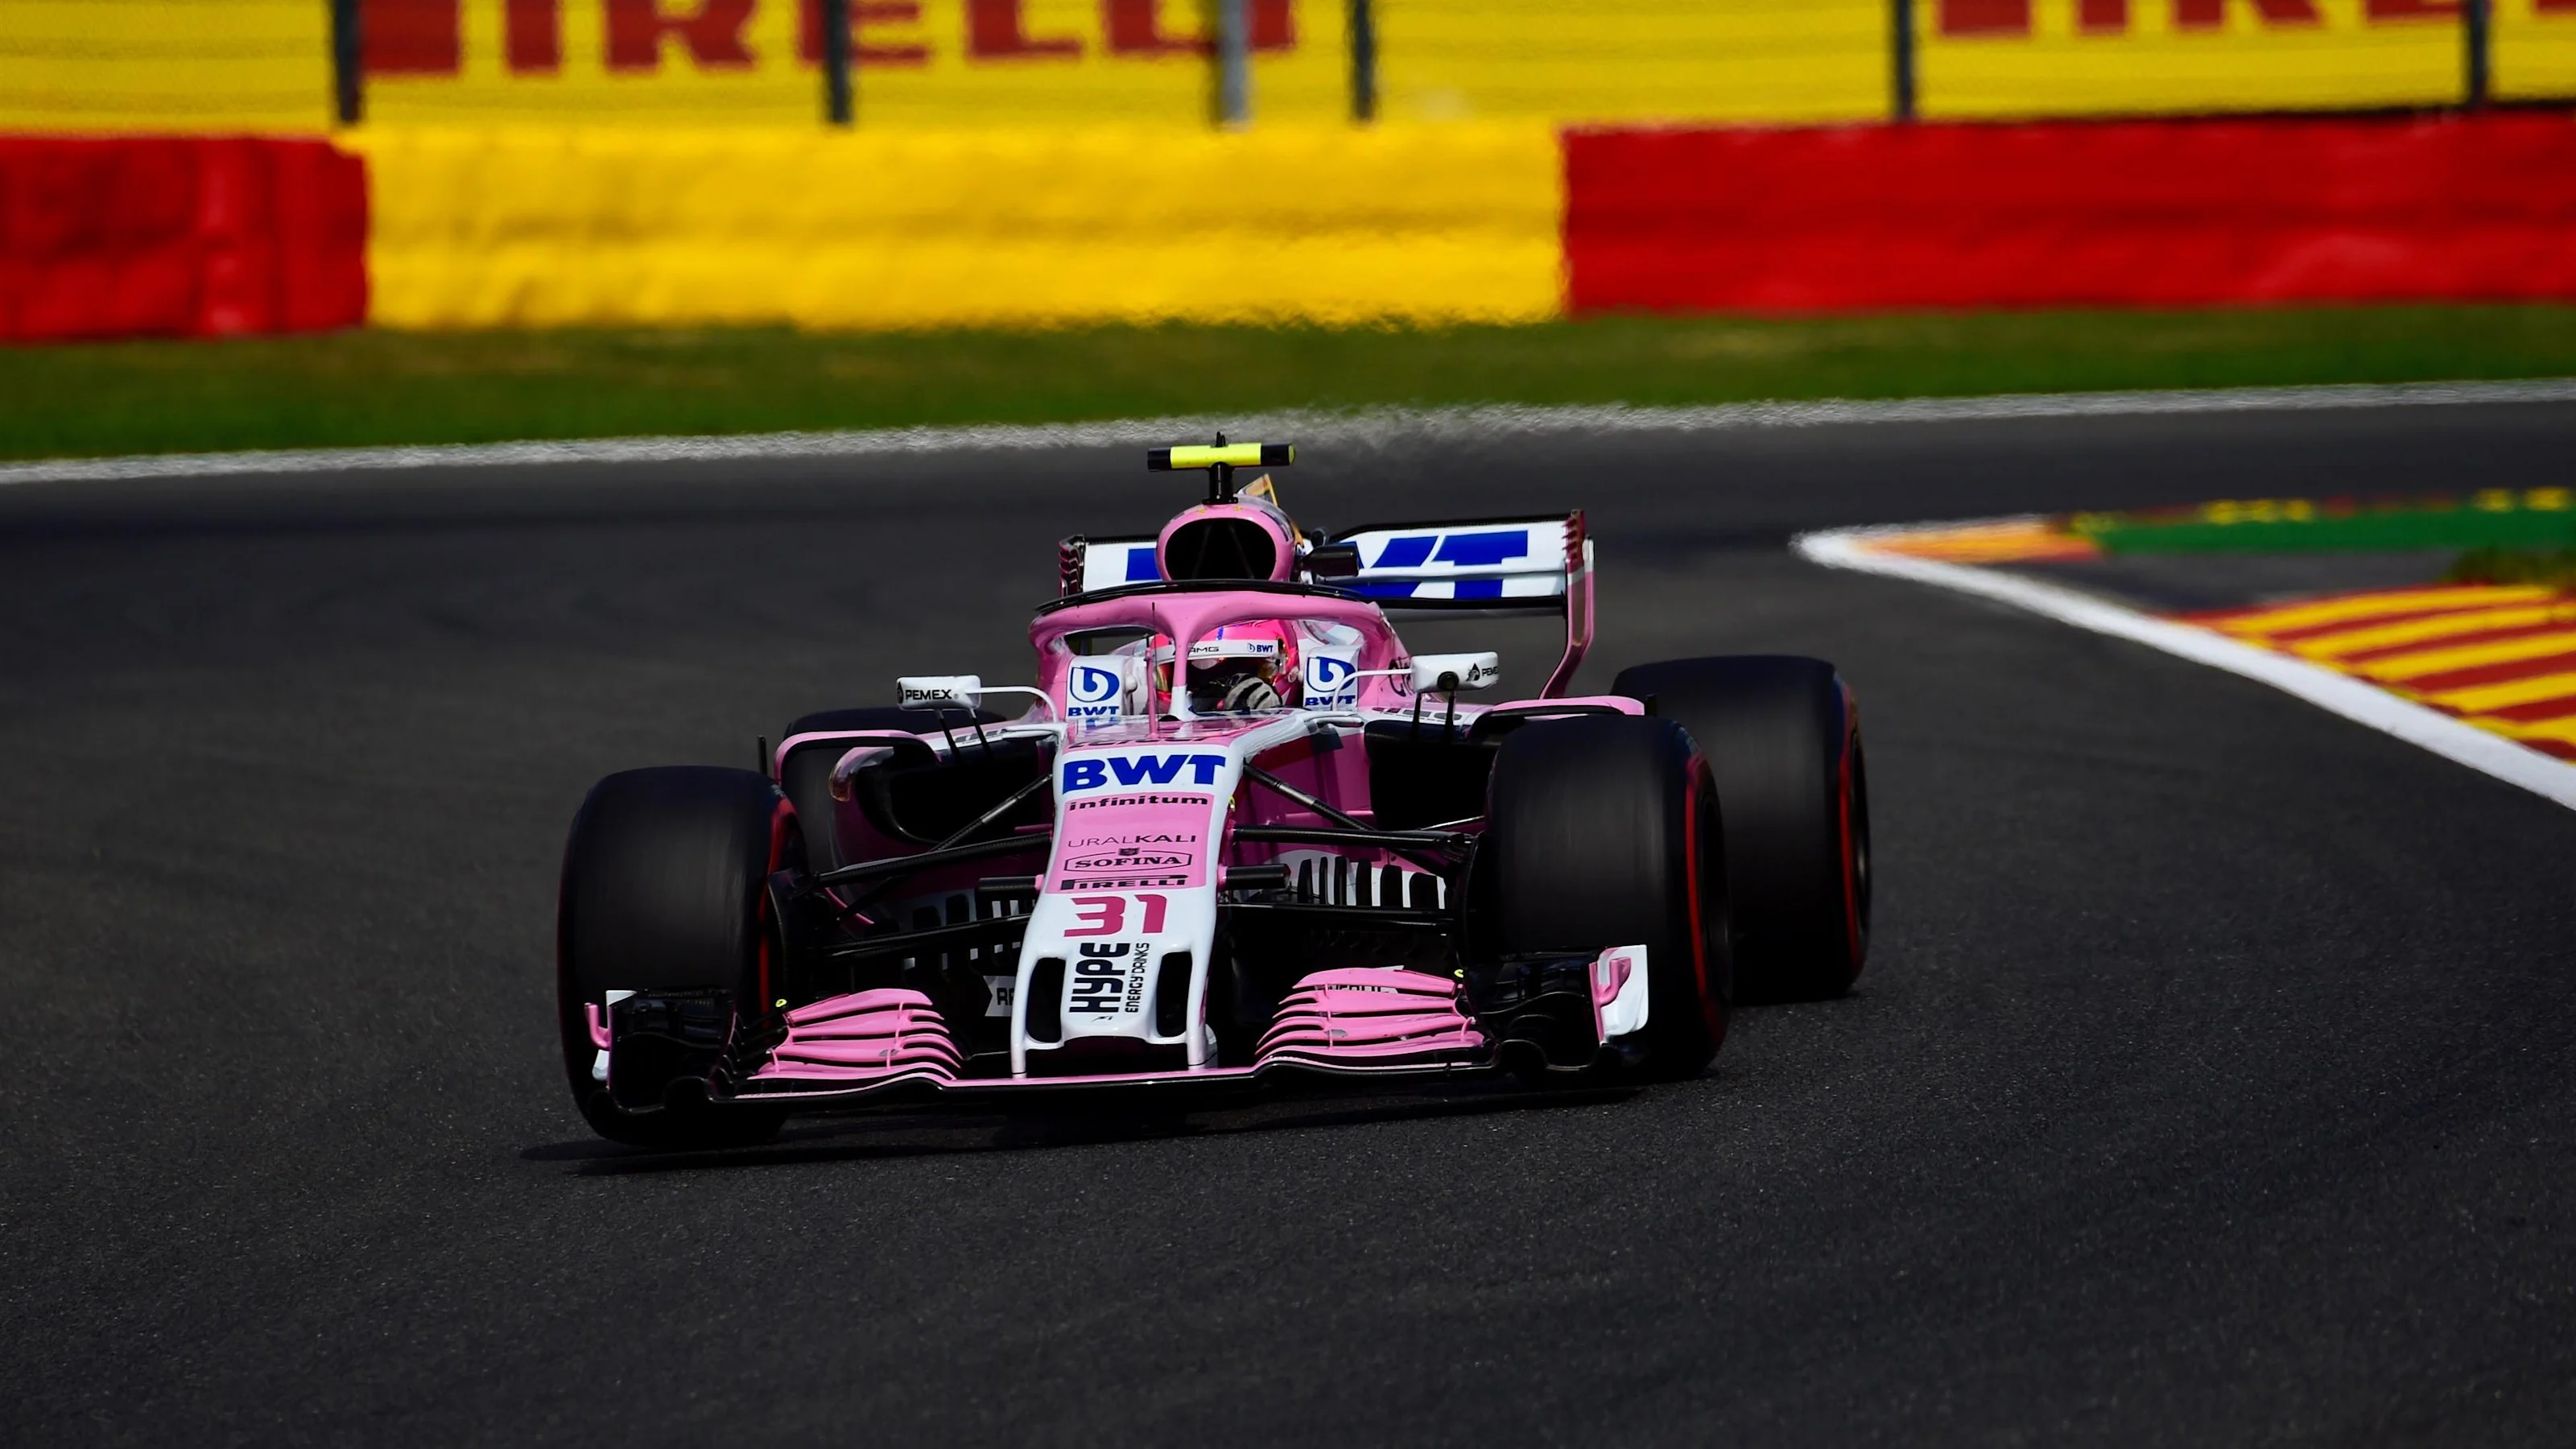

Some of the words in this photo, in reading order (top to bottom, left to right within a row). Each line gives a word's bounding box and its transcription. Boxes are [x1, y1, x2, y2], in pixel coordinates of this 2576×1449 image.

[1257, 645, 1274, 653] BWT
[905, 689, 952, 700] PEMEX
[1305, 695, 1356, 707] BWT
[1067, 706, 1120, 716] BWT
[1063, 754, 1227, 795] BWT
[1069, 795, 1208, 811] infinitum
[1068, 835, 1197, 848] URALKALI
[1075, 857, 1182, 869] SOFINA
[1059, 874, 1189, 891] PIRELLI
[1063, 894, 1167, 938] 31
[1131, 942, 1150, 974] DRINKS
[1068, 942, 1131, 1013] HYPE
[1125, 976, 1144, 1013] ENERGY
